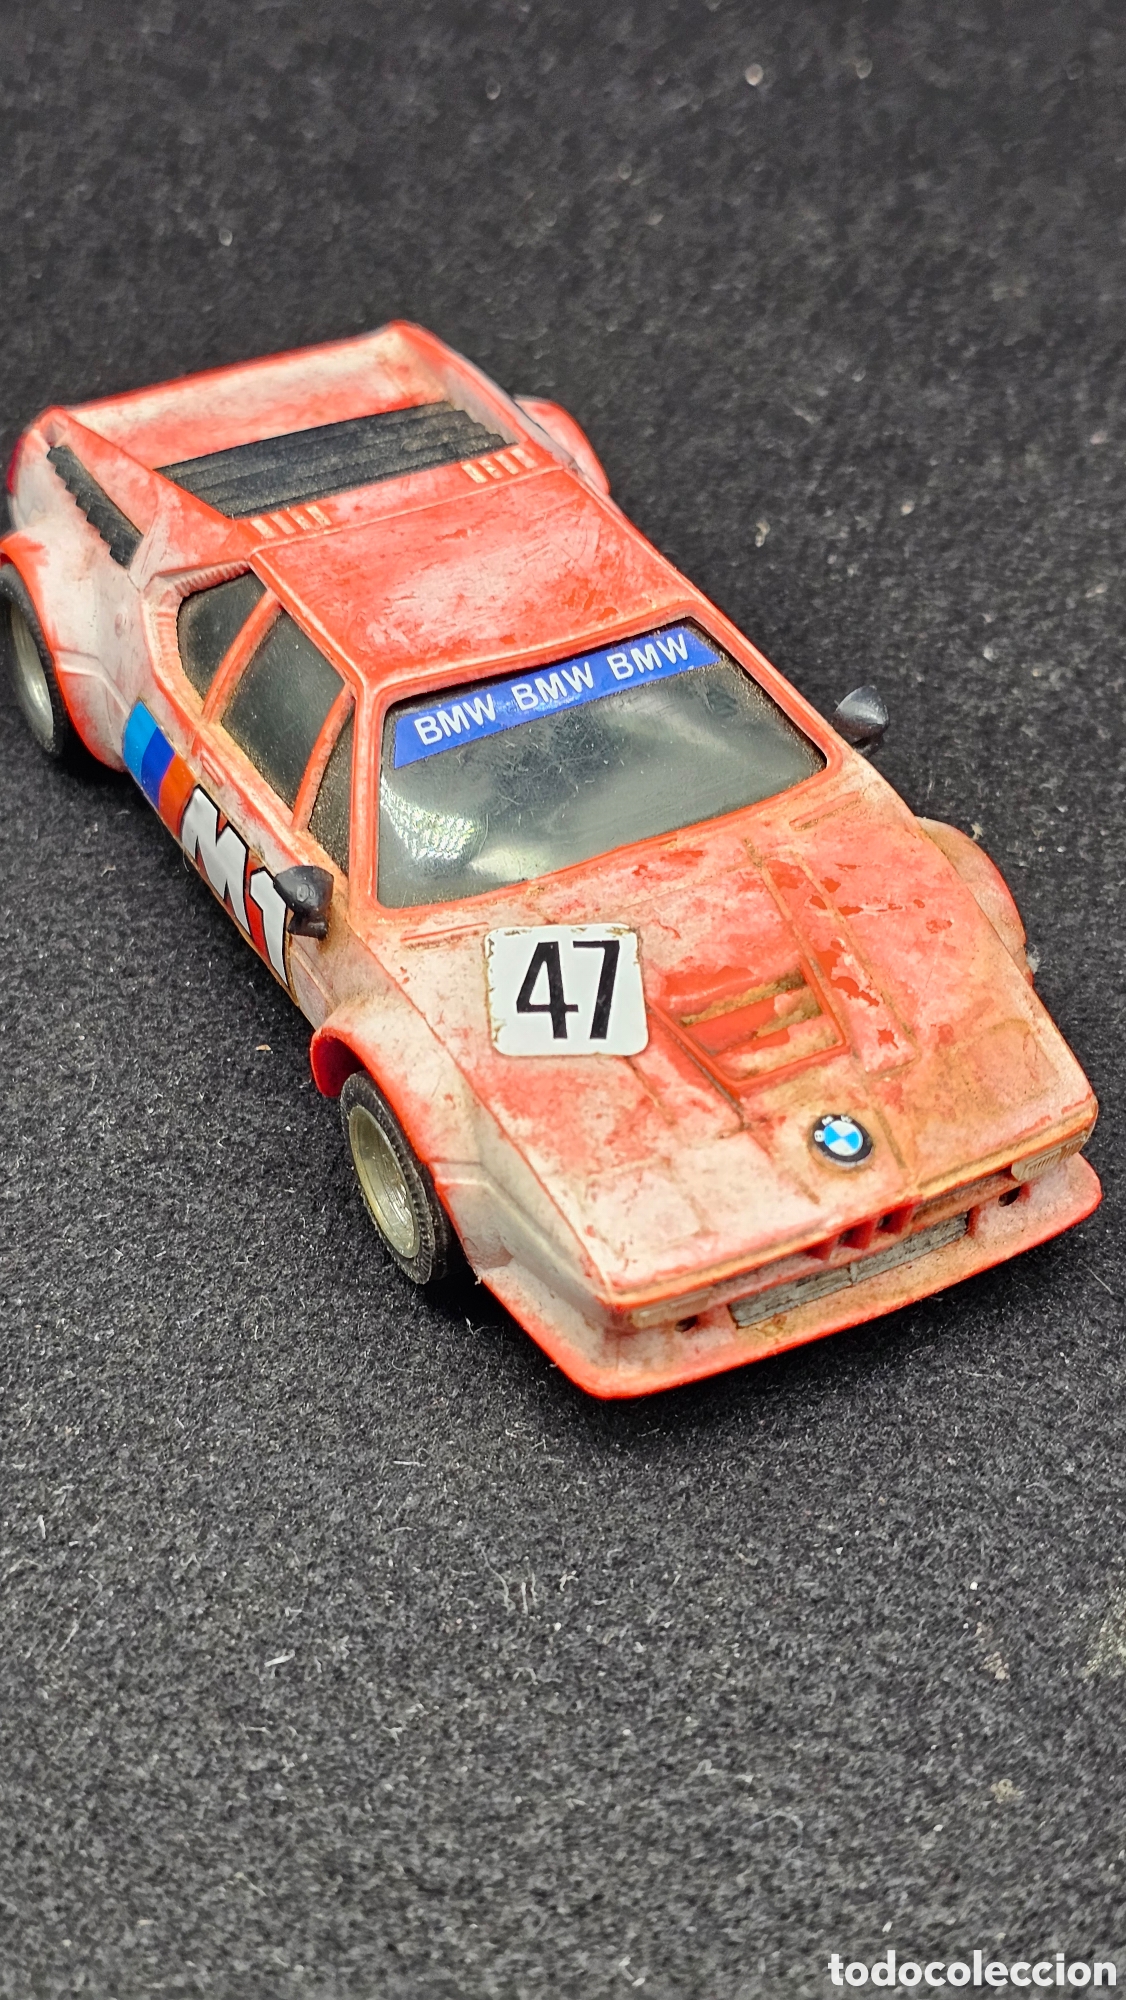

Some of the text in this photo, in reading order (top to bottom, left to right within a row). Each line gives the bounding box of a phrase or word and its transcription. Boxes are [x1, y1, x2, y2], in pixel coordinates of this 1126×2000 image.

[413, 633, 690, 746] BMW BMW BMW
[180, 786, 289, 988] M1
[515, 940, 621, 1040] 47
